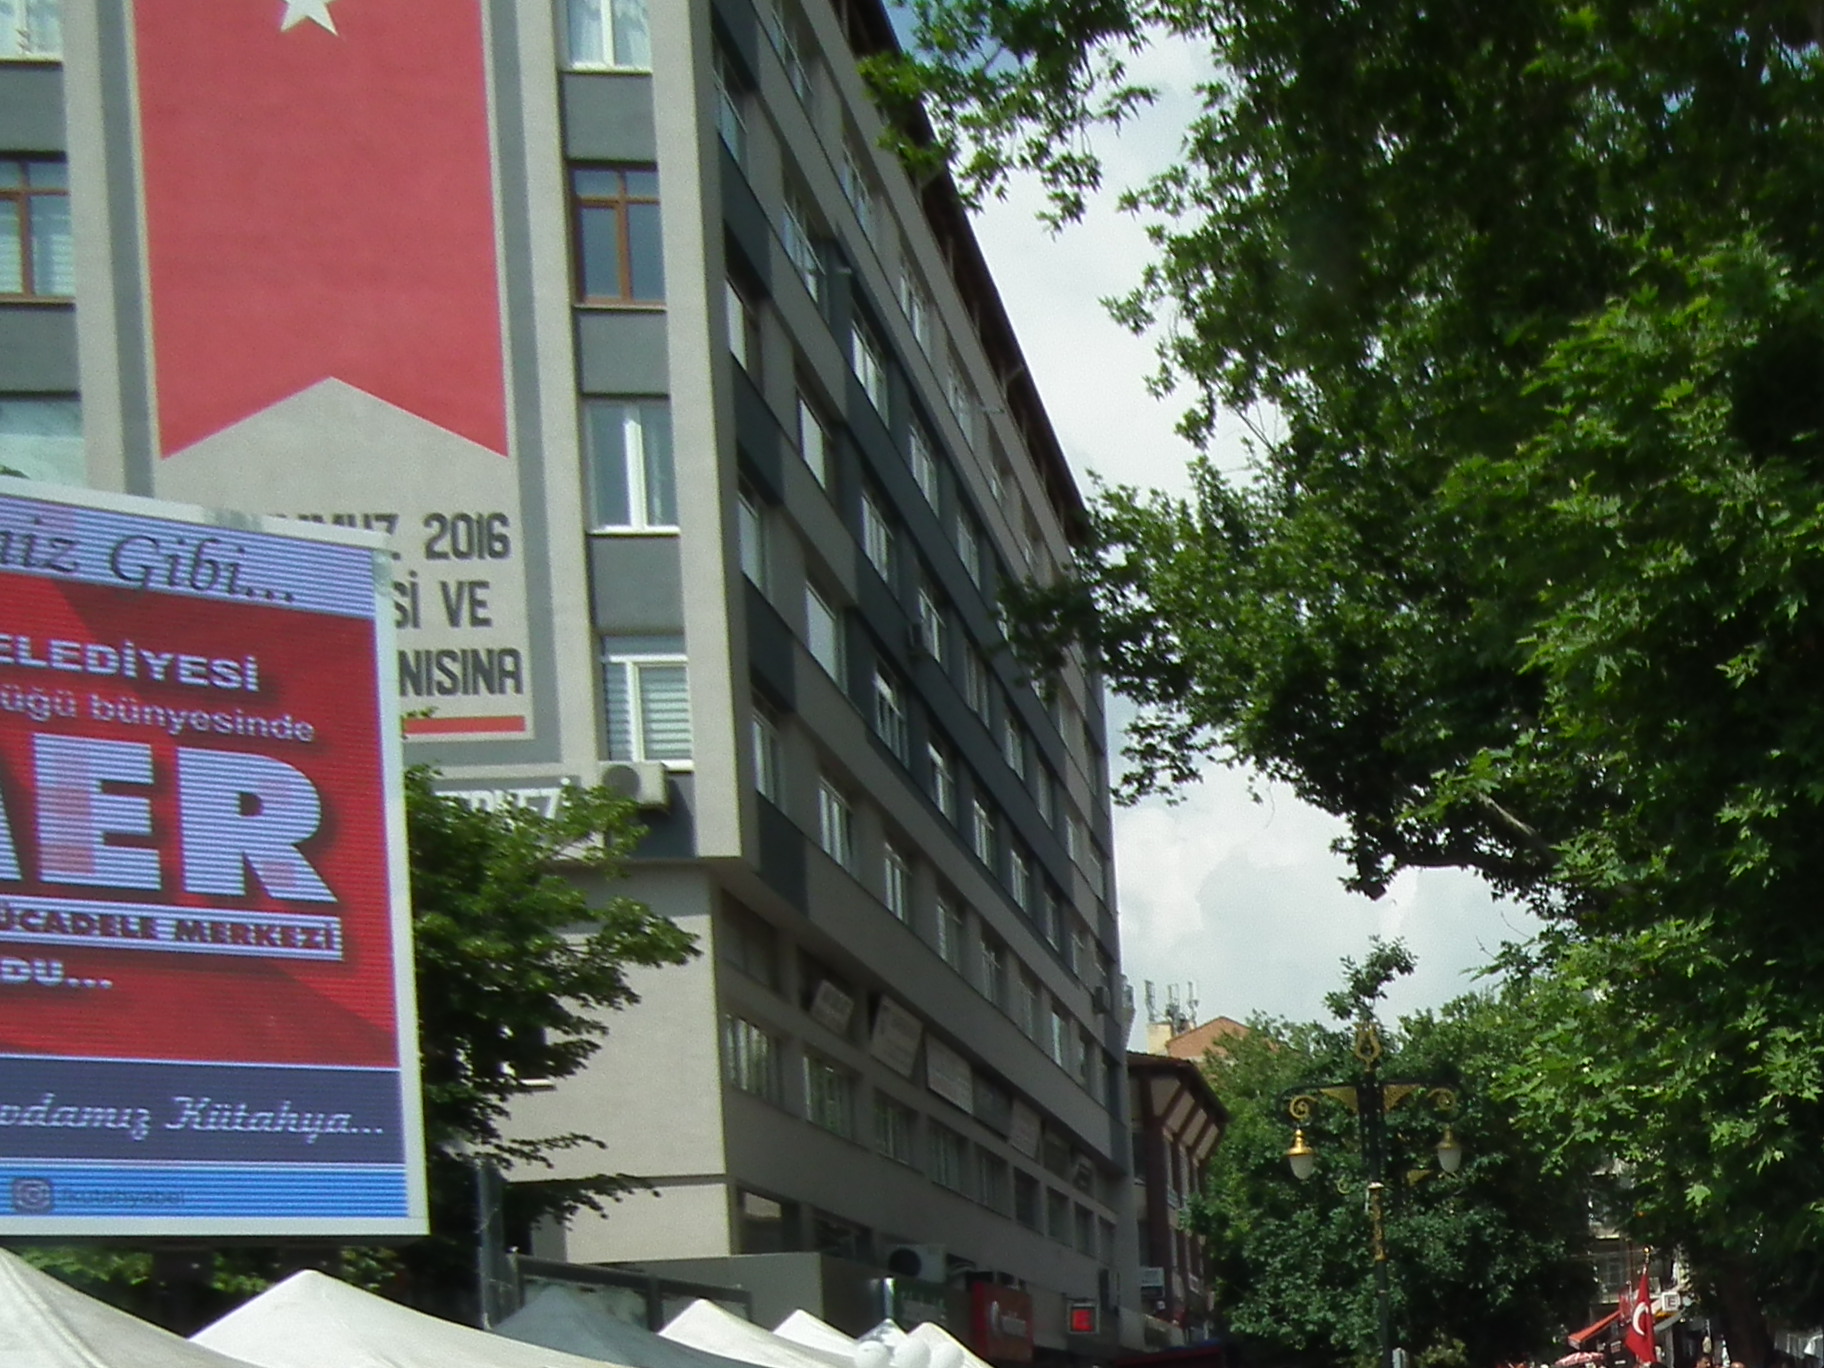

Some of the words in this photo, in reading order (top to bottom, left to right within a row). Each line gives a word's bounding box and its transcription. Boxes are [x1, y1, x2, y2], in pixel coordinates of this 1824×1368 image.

[423, 512, 513, 561] 2016
[110, 535, 294, 602] Gibi...
[439, 580, 493, 629] VE
[90, 694, 315, 742] bünyesinde
[0, 733, 338, 903] ER
[174, 918, 335, 948] MERKEZİ
[164, 1096, 384, 1144] Kütahya...
